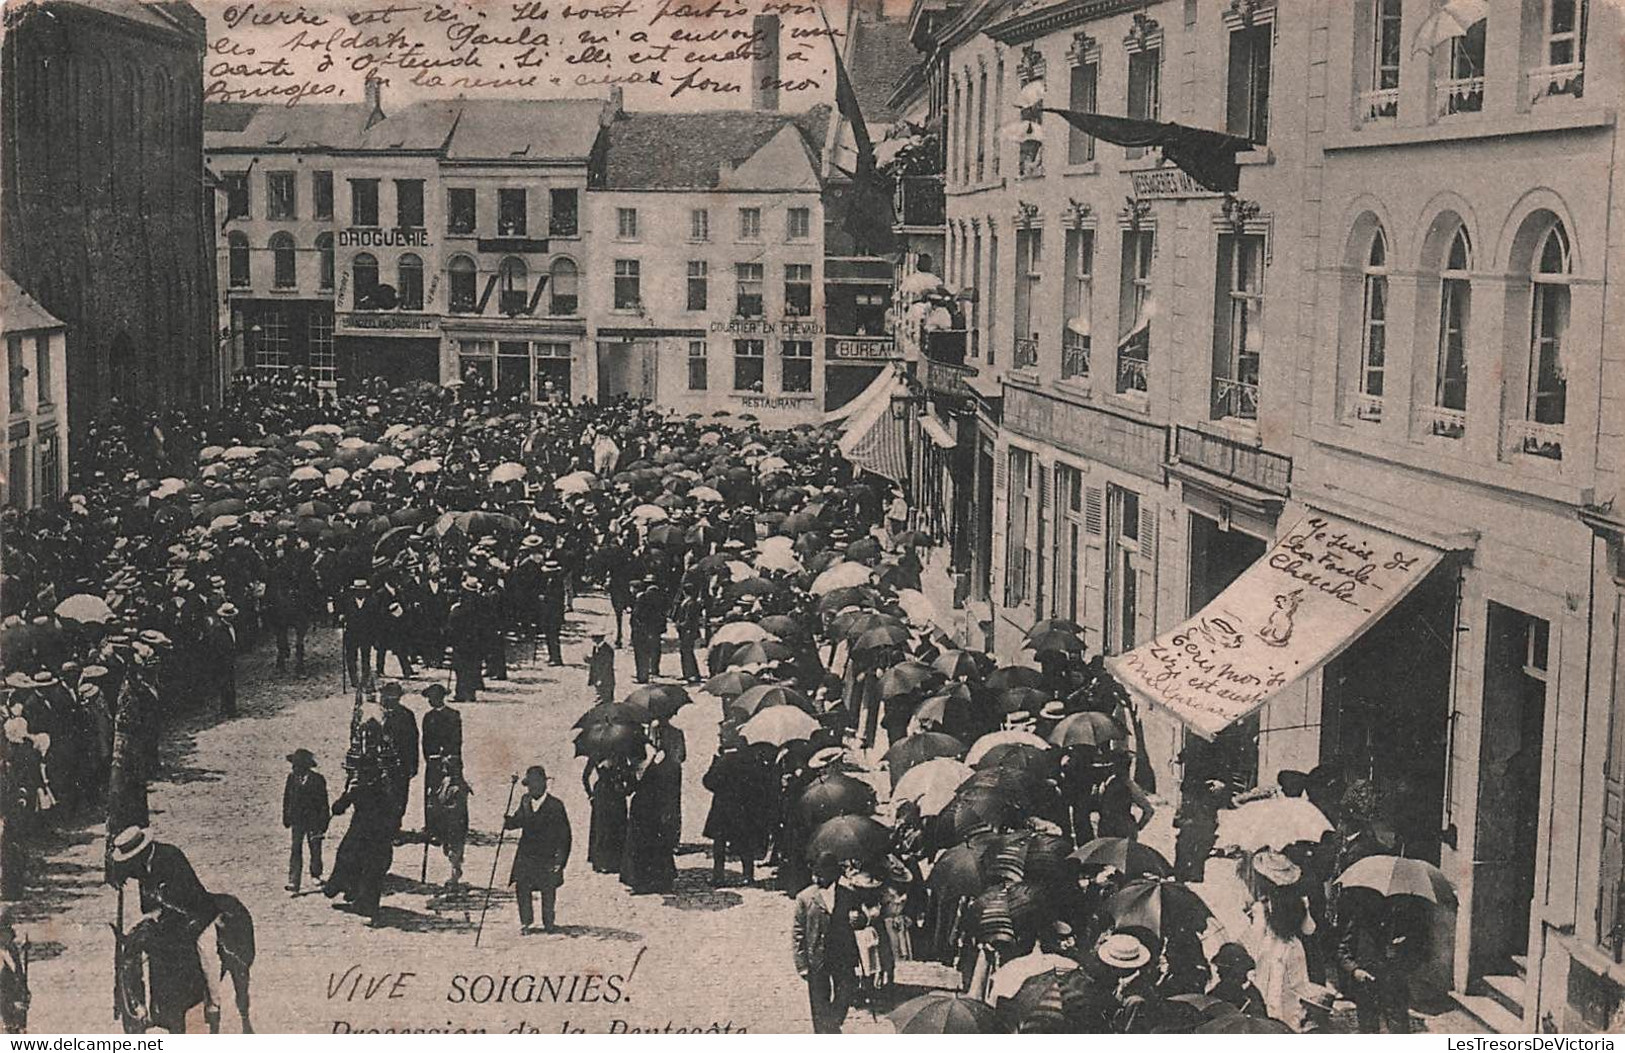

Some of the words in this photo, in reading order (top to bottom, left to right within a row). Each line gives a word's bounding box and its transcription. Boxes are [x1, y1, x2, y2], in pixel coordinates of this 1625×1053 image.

[711, 322, 756, 334] COURTIER
[763, 322, 775, 333] EN
[782, 323, 825, 334] CHEVAUX
[742, 398, 801, 409] RESTAURANT
[327, 964, 416, 1001] VIVE
